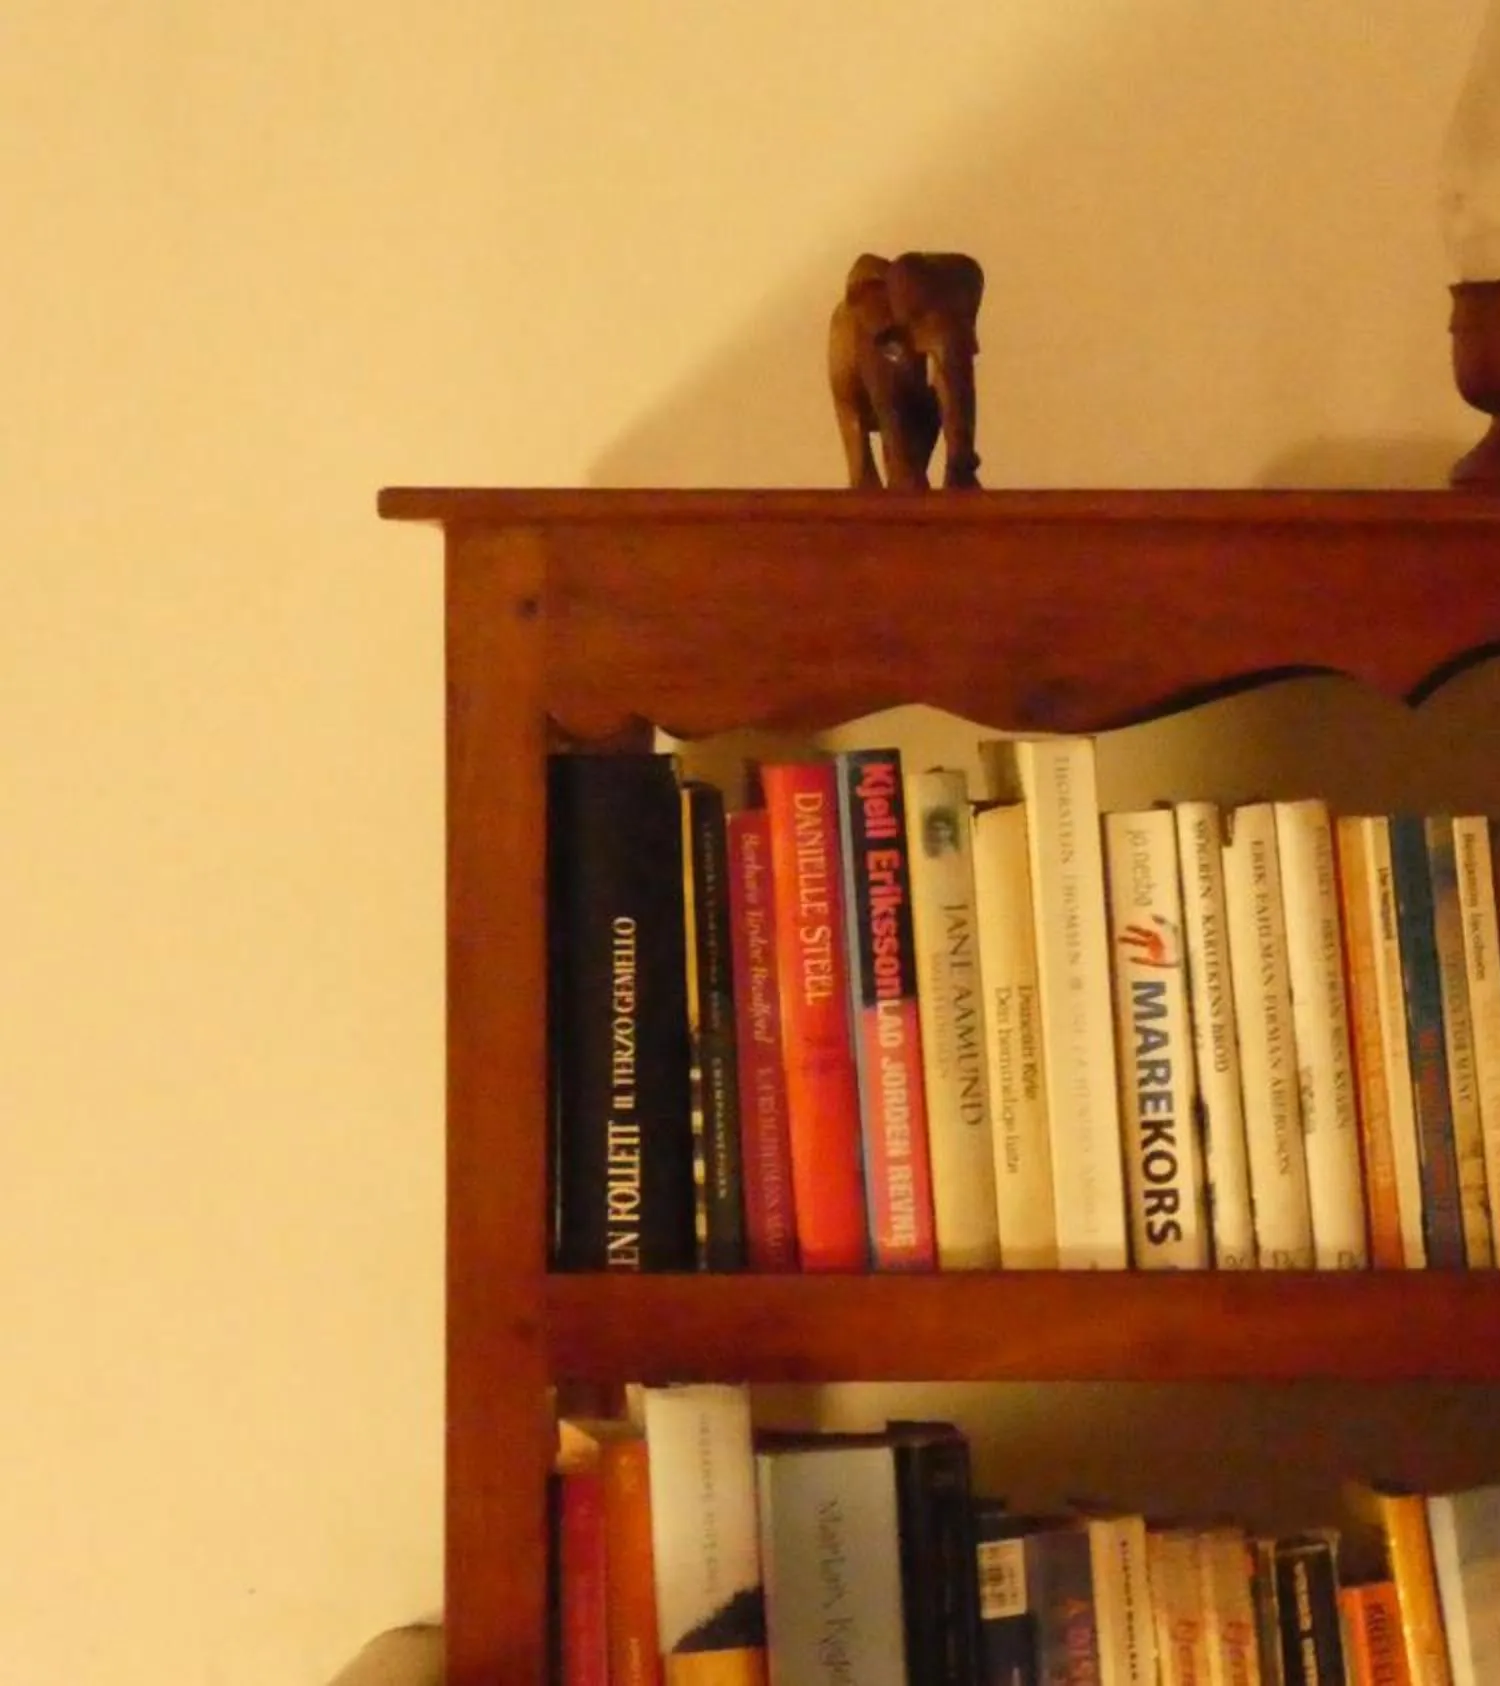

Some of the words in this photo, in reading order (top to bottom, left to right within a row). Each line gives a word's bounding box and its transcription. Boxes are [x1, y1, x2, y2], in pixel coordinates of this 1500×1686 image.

[856, 764, 899, 839] Kjell
[739, 832, 764, 912] Barbara
[793, 792, 829, 918] DANIELLE
[1249, 839, 1269, 884] ERIK
[611, 916, 637, 1015] GEMELLO
[867, 850, 904, 1000] Eriksson
[941, 903, 973, 977] JANE
[1253, 891, 1277, 989] FAHLMAN
[746, 968, 775, 1045] Bradford
[800, 926, 834, 1006] STEEL
[611, 1016, 636, 1087] TERZO
[877, 1000, 903, 1048] LAD
[949, 983, 985, 1127] AAMUND
[1261, 993, 1284, 1074] FIRMAN
[879, 1057, 910, 1160] JORDEN
[1130, 979, 1182, 1248] MAREKORS
[605, 1119, 642, 1223] FOLLETT
